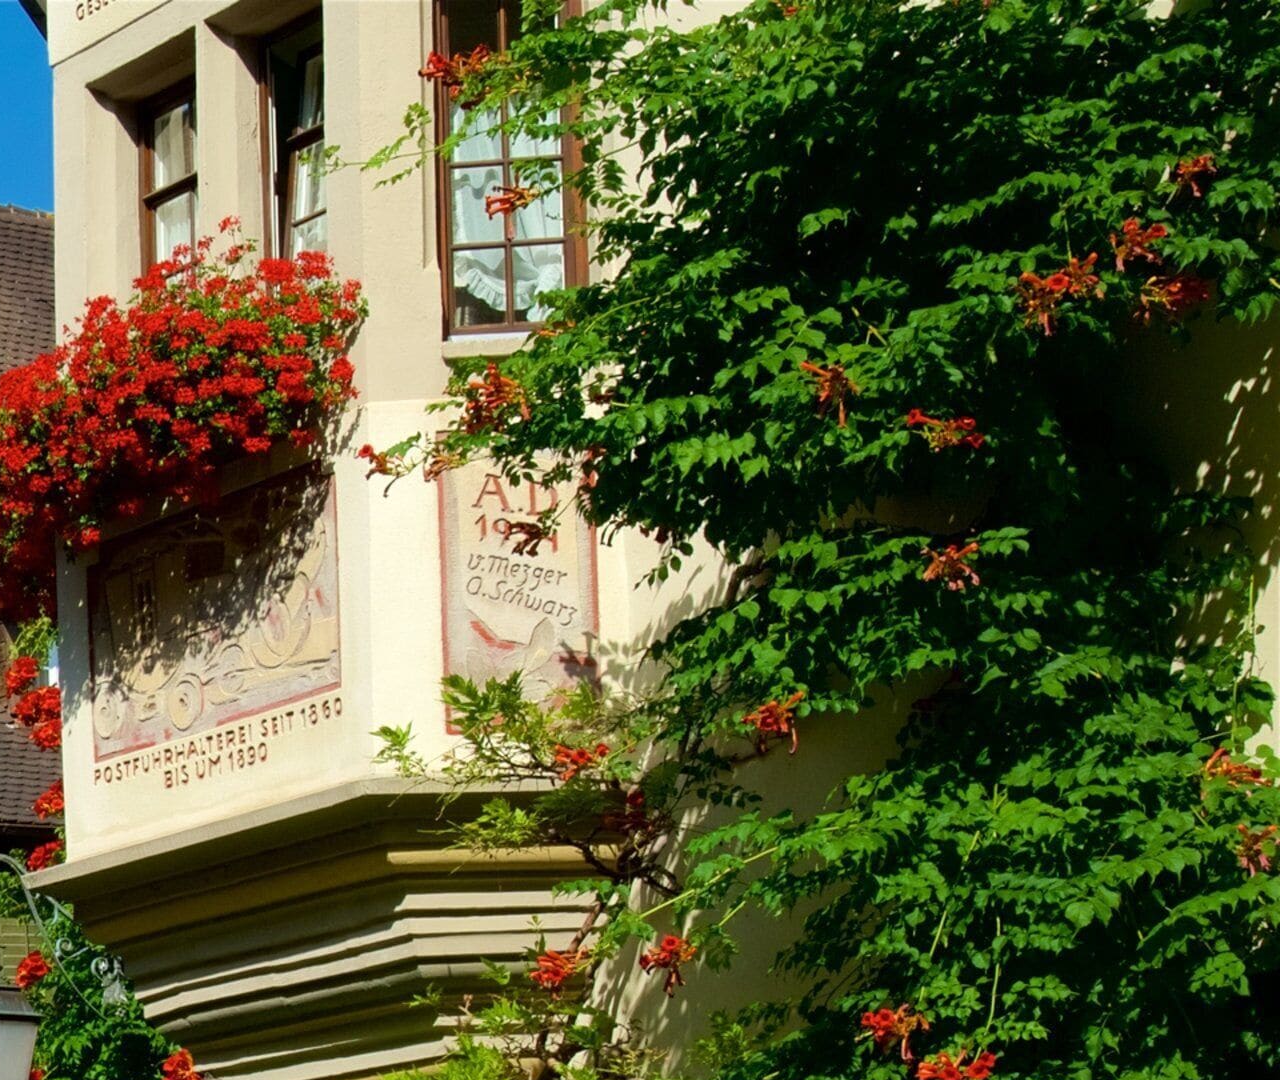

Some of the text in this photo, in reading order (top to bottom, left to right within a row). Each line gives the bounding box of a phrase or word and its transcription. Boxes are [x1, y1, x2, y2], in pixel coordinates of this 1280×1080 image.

[261, 711, 294, 738] SEIT
[300, 697, 343, 727] 1860
[164, 764, 189, 789] BIS
[195, 755, 222, 779] UM
